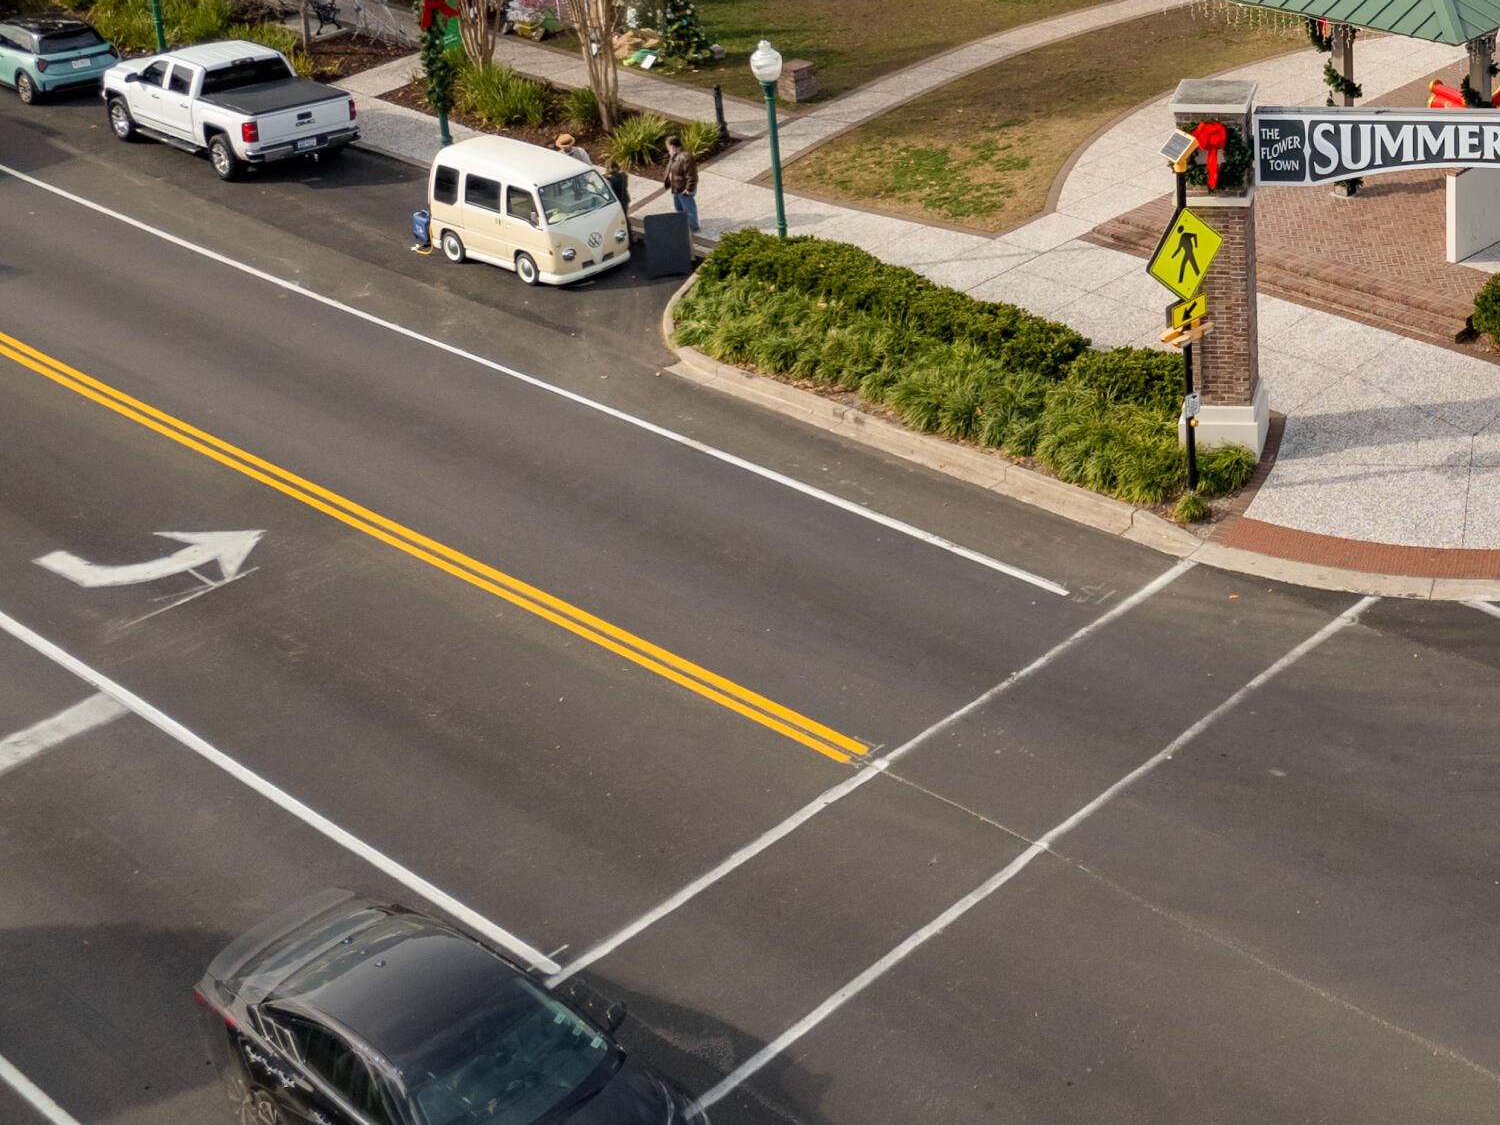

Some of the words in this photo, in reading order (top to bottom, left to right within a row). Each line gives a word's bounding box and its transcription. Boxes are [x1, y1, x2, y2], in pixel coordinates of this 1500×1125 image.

[1260, 128, 1280, 140] THE
[1260, 135, 1301, 161] FLOWER
[1268, 159, 1299, 171] TOWN
